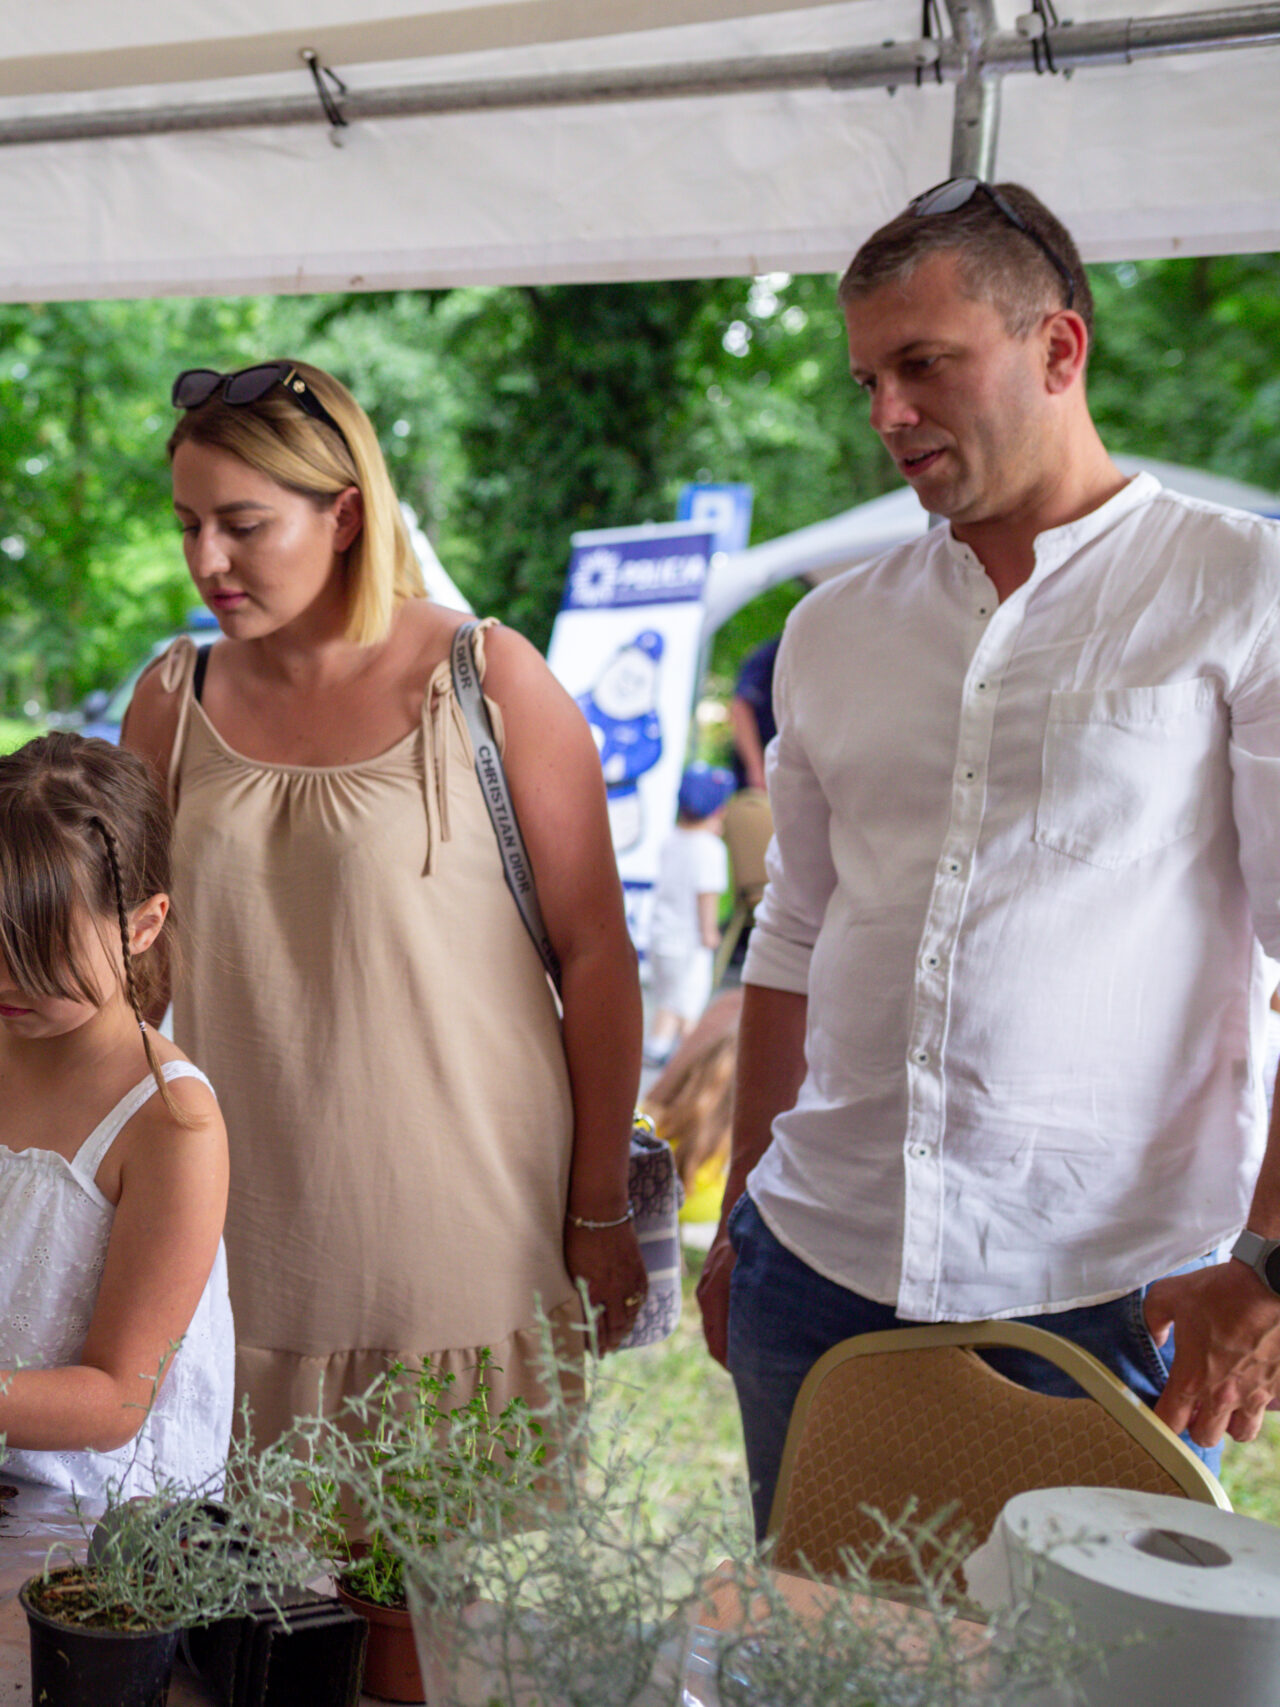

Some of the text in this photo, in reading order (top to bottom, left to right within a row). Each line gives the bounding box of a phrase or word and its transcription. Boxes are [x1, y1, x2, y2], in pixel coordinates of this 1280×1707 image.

[456, 645, 473, 690] DIOR
[478, 745, 532, 895] CHRISTIAN DIOR
